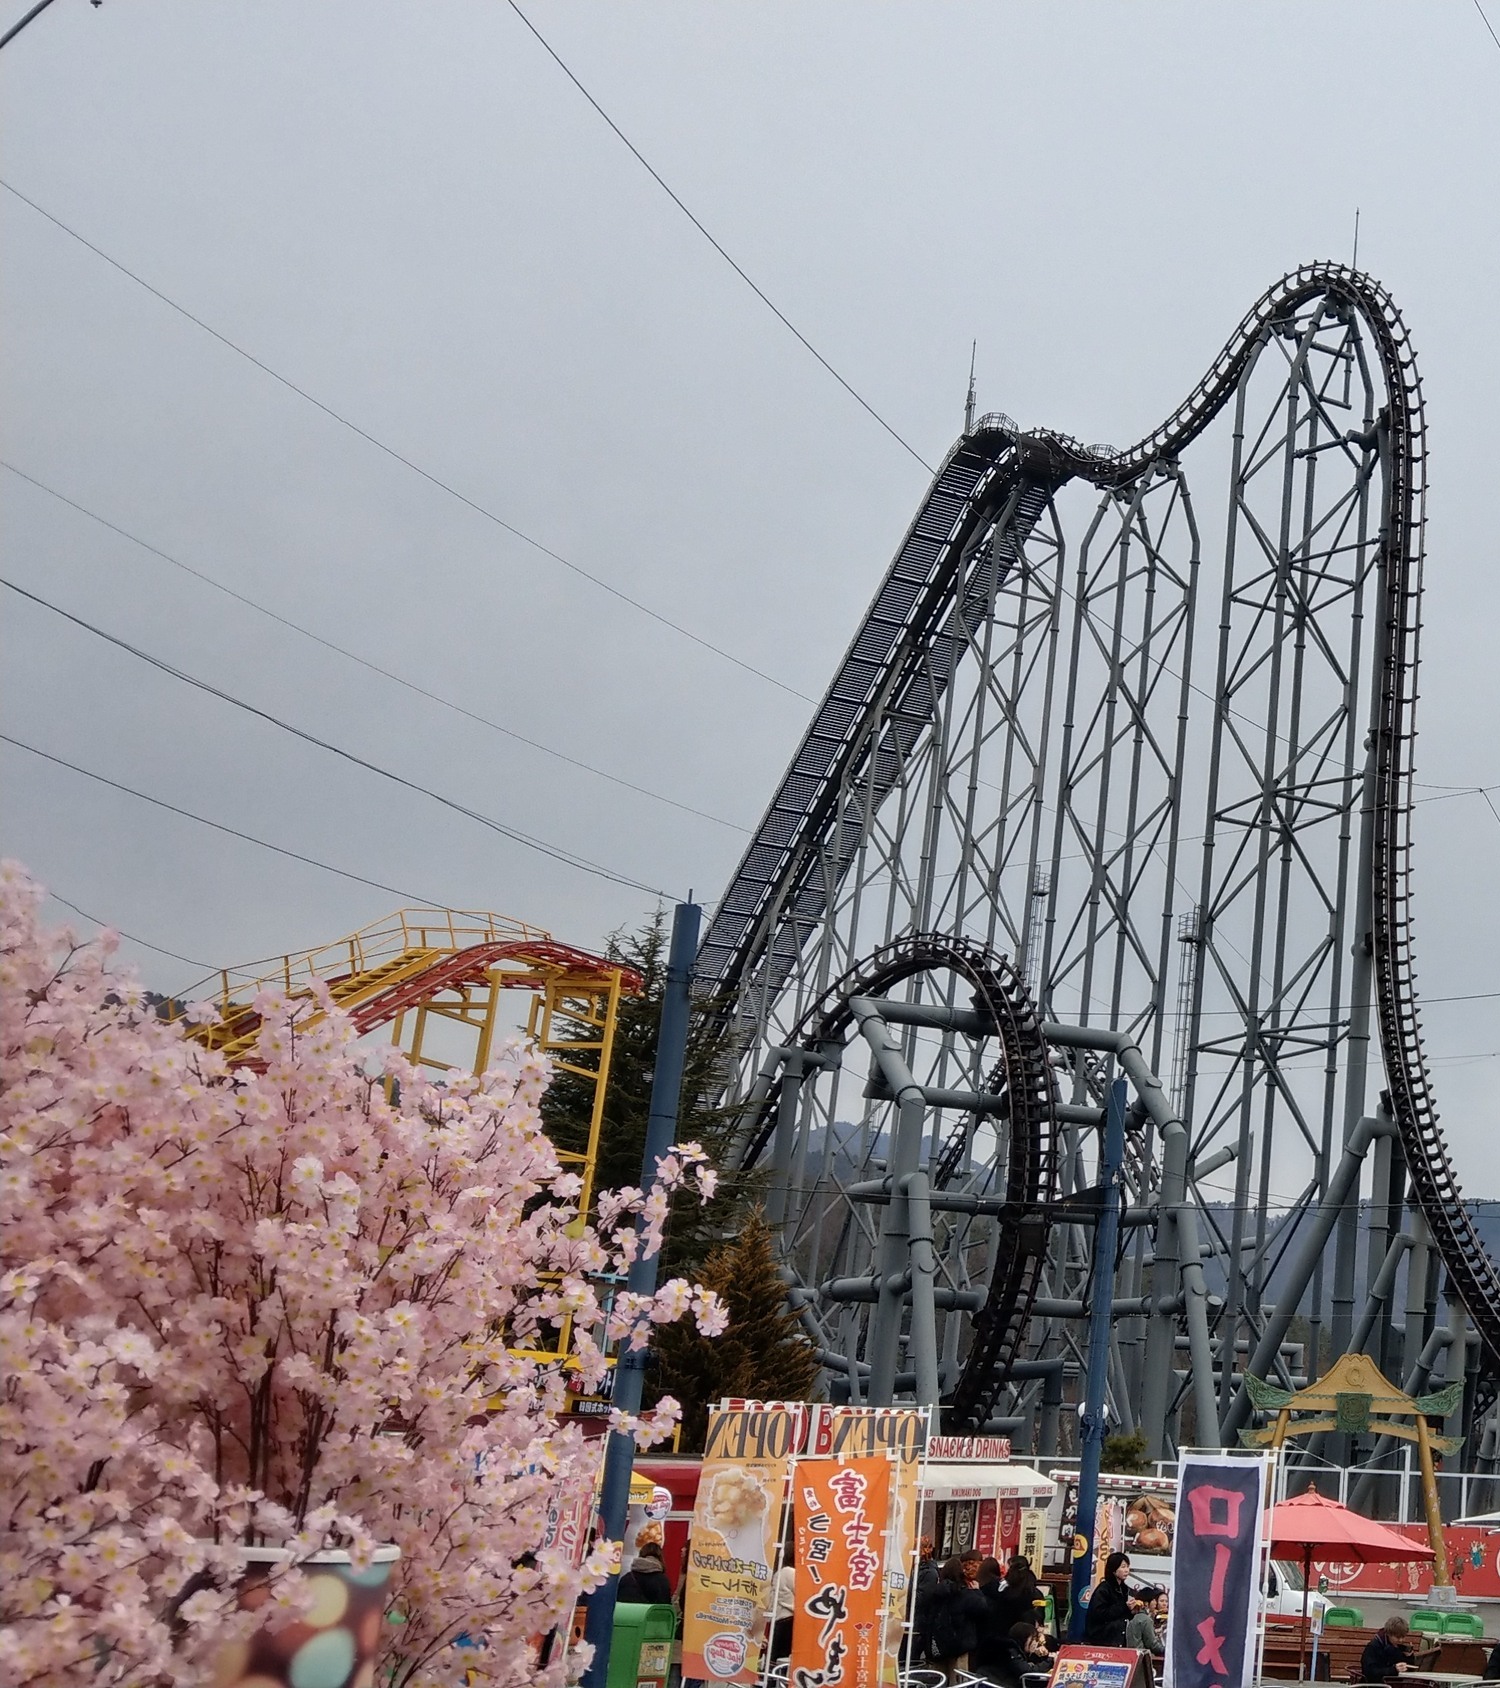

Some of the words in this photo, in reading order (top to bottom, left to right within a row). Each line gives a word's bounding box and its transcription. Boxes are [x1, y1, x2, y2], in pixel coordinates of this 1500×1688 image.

[1346, 1369, 1365, 1388] Q
[928, 1437, 965, 1458] SNACK
[964, 1438, 973, 1458] &
[975, 1438, 1011, 1459] DRINKS
